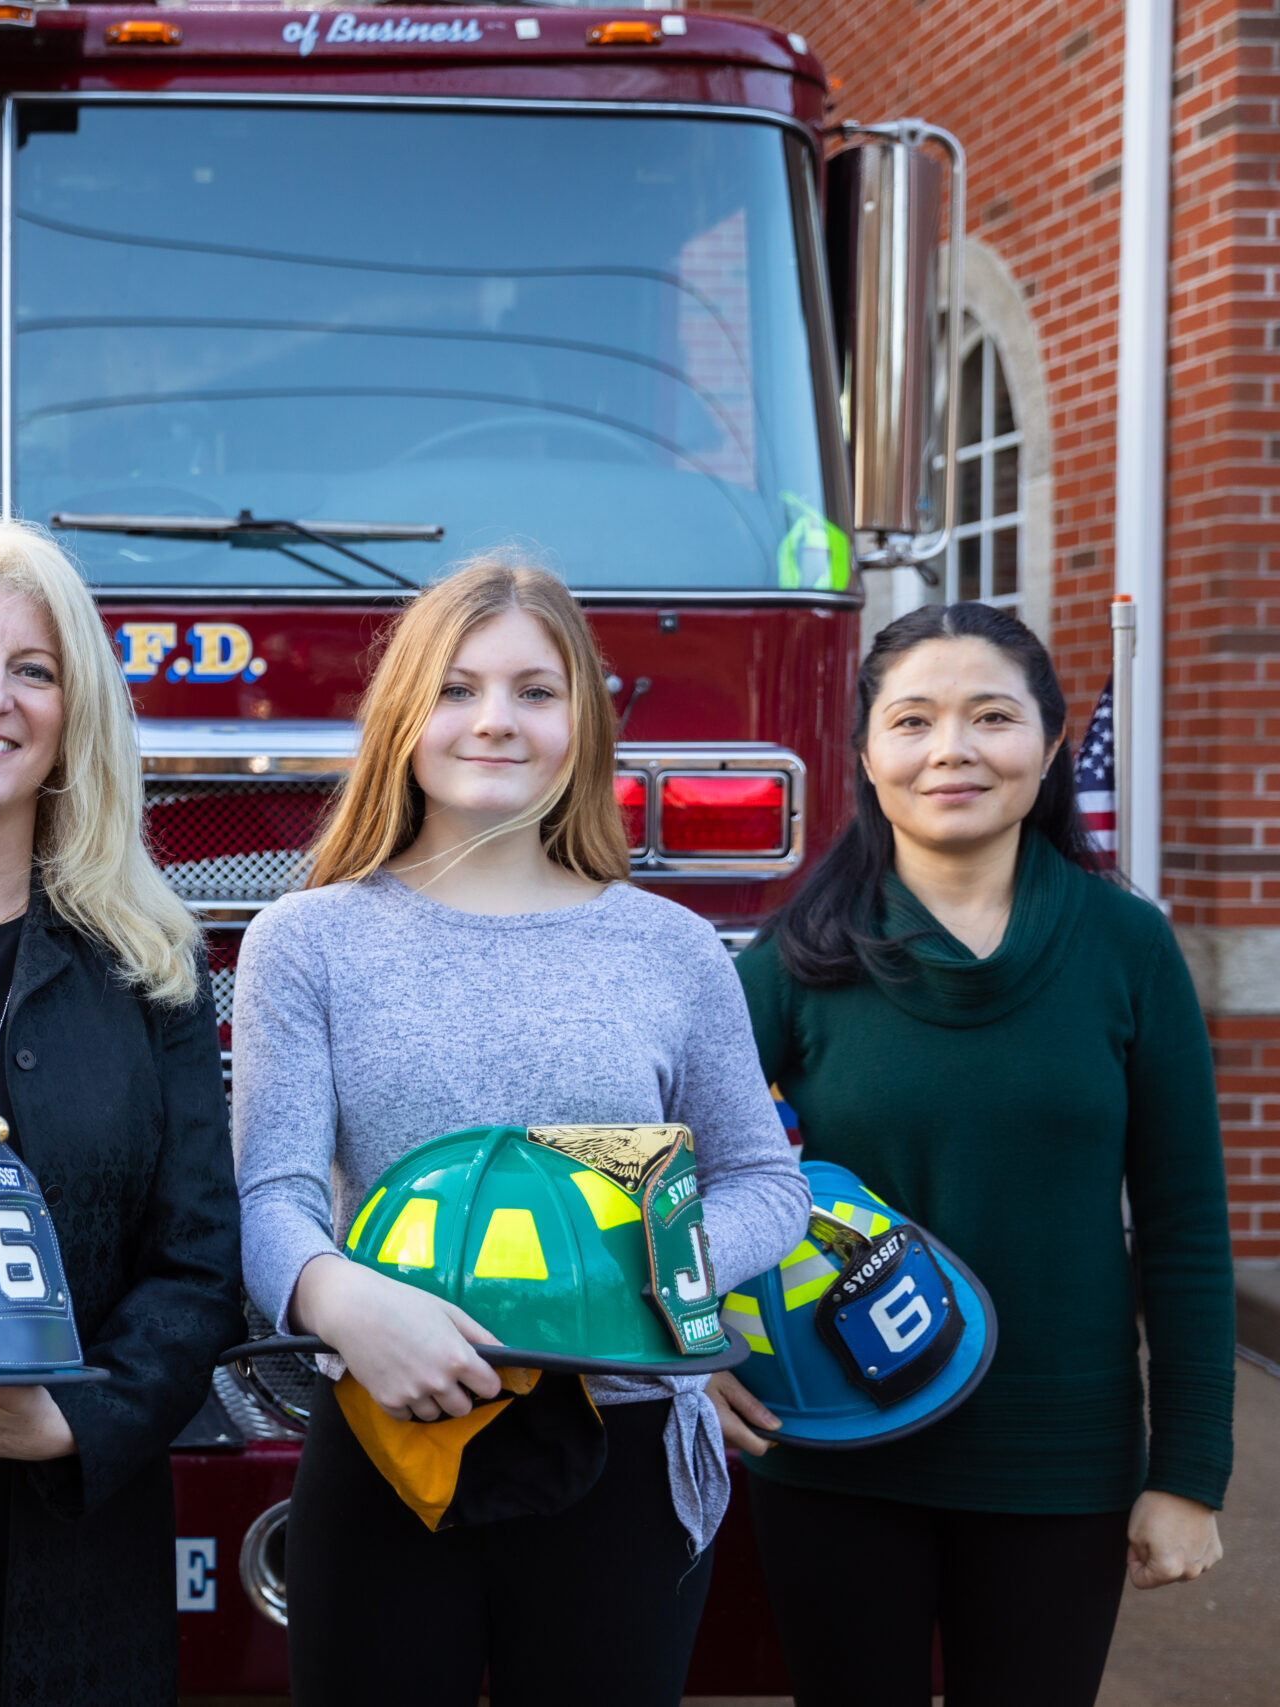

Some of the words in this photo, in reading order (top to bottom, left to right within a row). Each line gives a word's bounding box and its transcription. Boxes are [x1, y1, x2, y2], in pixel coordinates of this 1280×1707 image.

[282, 12, 320, 57] of
[325, 13, 483, 43] Business
[116, 622, 268, 683] F.D.
[667, 1173, 697, 1205] SYOS
[675, 1225, 709, 1301] J
[842, 1234, 900, 1294] SYOSSET
[868, 1274, 932, 1353] 6
